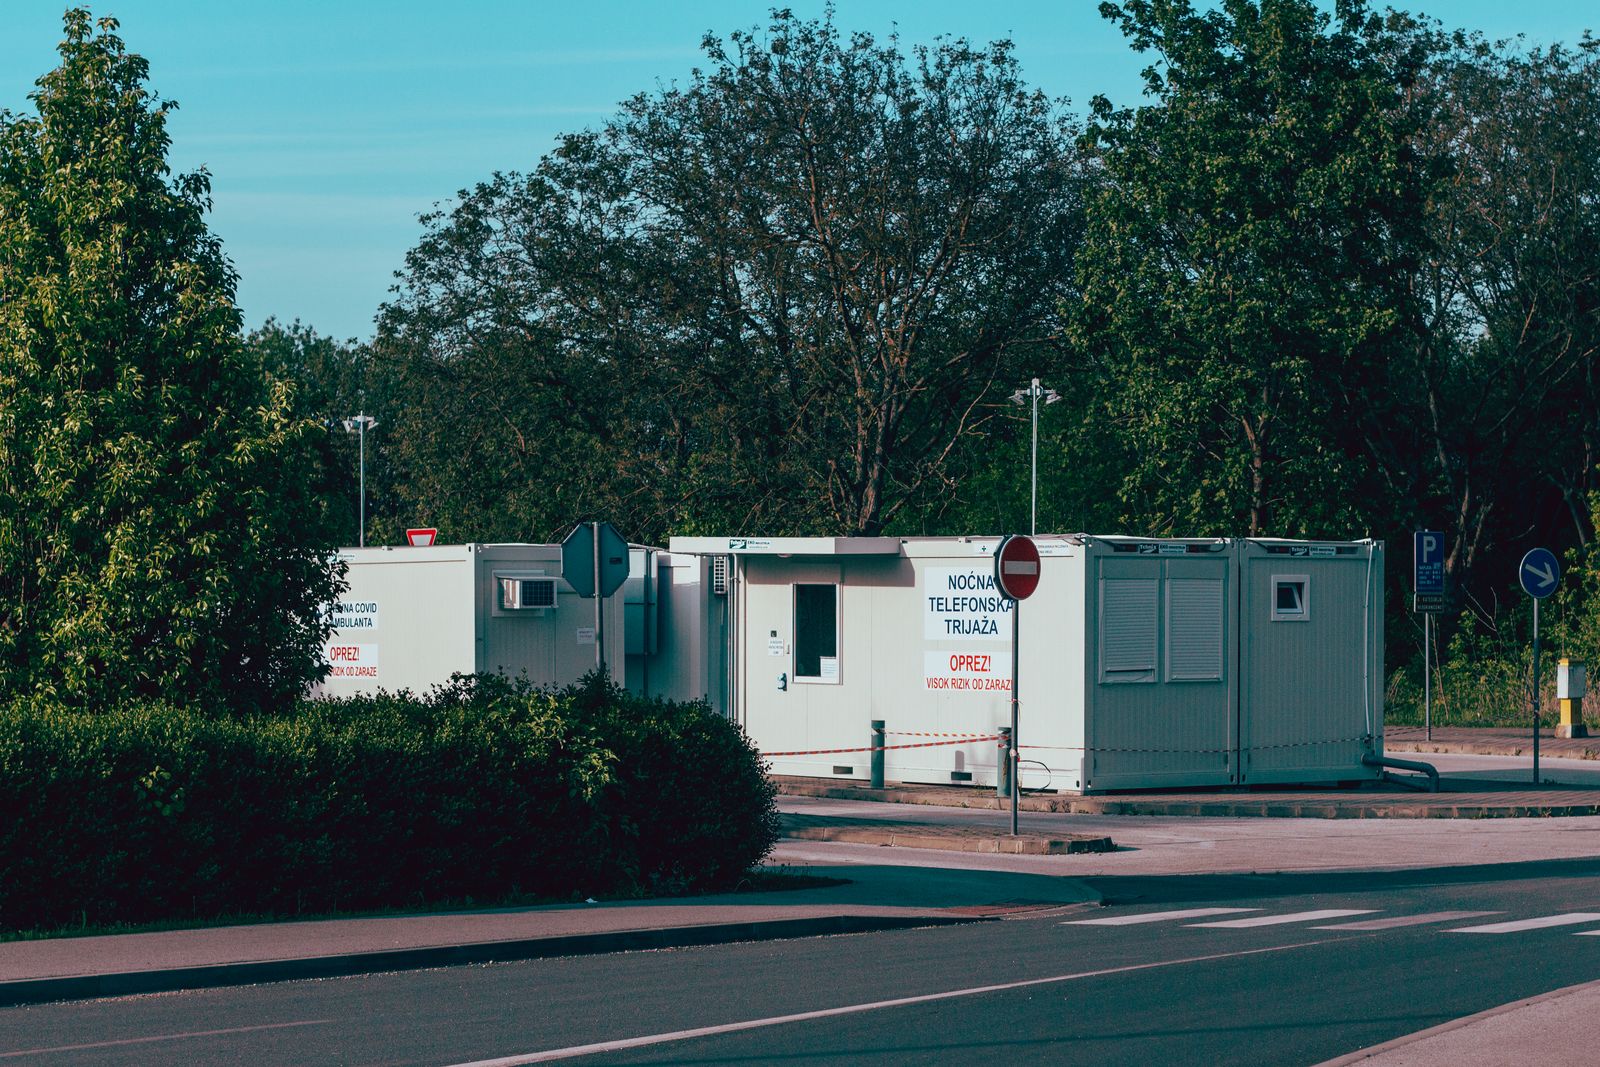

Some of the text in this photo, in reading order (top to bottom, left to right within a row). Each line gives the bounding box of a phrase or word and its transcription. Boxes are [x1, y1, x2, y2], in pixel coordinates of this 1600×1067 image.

[1423, 536, 1437, 562] P
[948, 571, 995, 590] NOĆNA
[355, 602, 377, 613] COVID
[929, 597, 1014, 612] TELEFONSKA
[944, 616, 999, 635] TRIJAŽA
[330, 647, 360, 661] OPREZ!
[949, 655, 991, 672] OPREZ!
[346, 667, 354, 677] OD
[355, 667, 377, 677] ZARAZE
[926, 677, 949, 689] VISOK
[951, 678, 970, 689] RIZIK
[972, 678, 984, 690] OD
